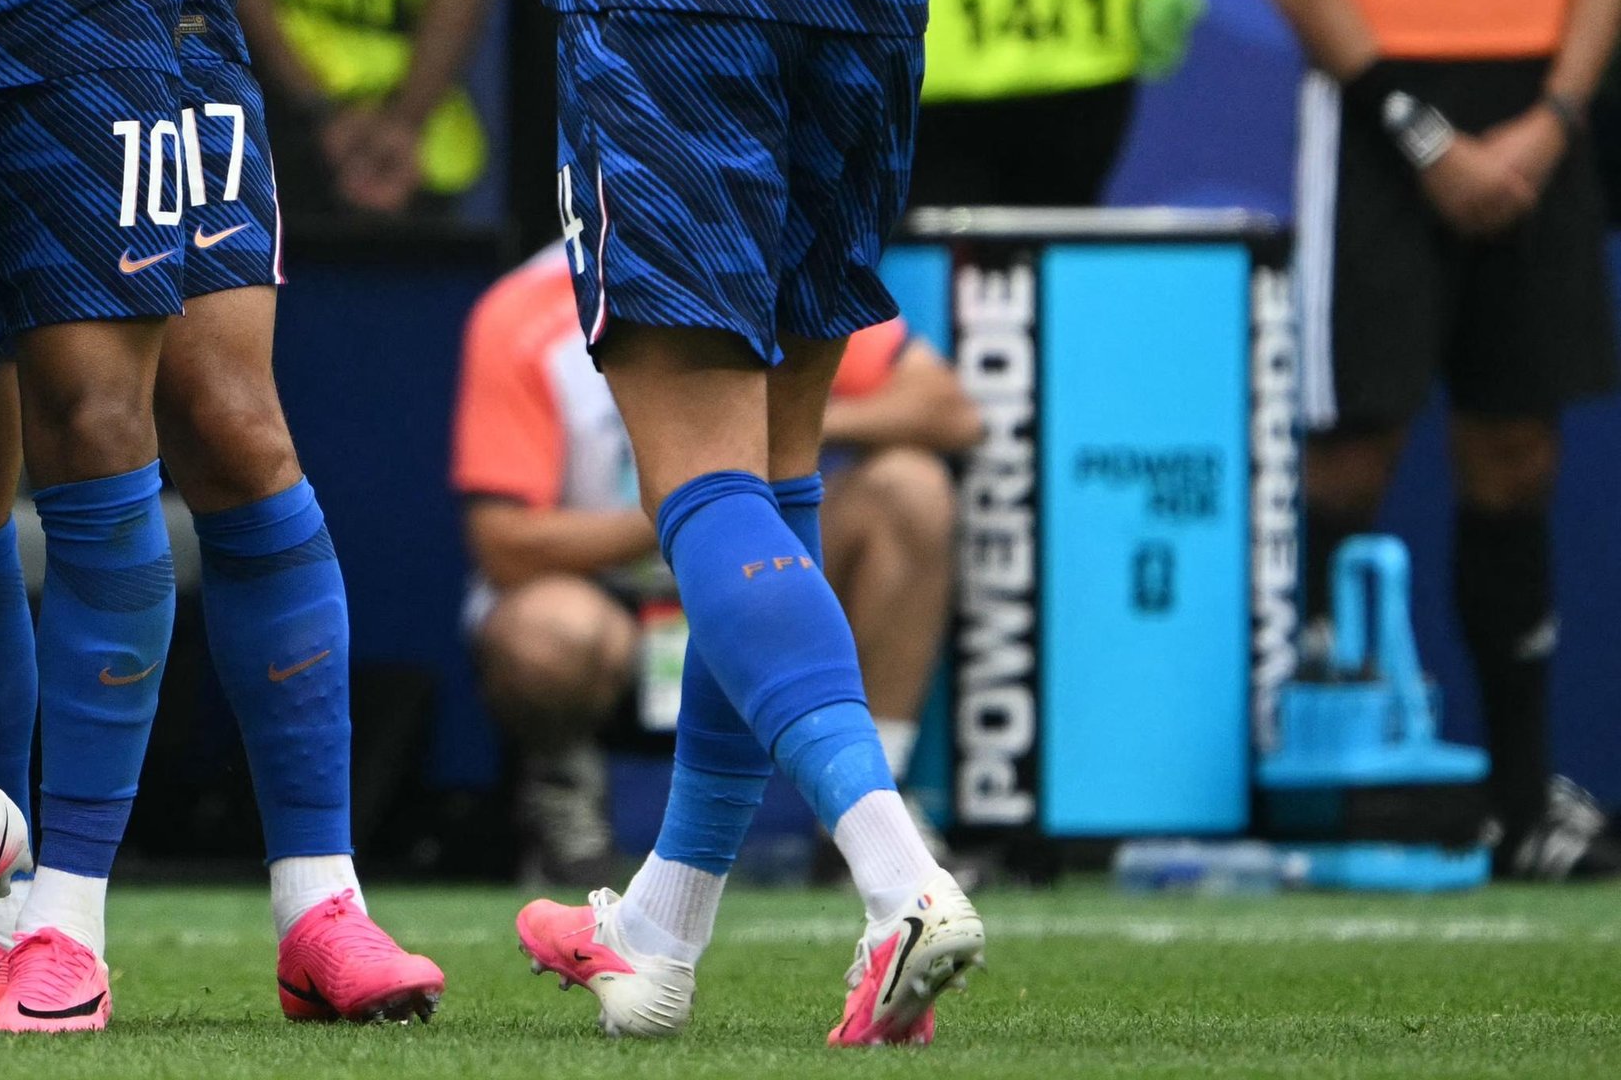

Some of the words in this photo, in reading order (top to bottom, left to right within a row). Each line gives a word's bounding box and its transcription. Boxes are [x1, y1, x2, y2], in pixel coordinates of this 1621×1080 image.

[113, 119, 182, 227] 10
[181, 103, 245, 207] 17
[957, 264, 1036, 826] POWERADE
